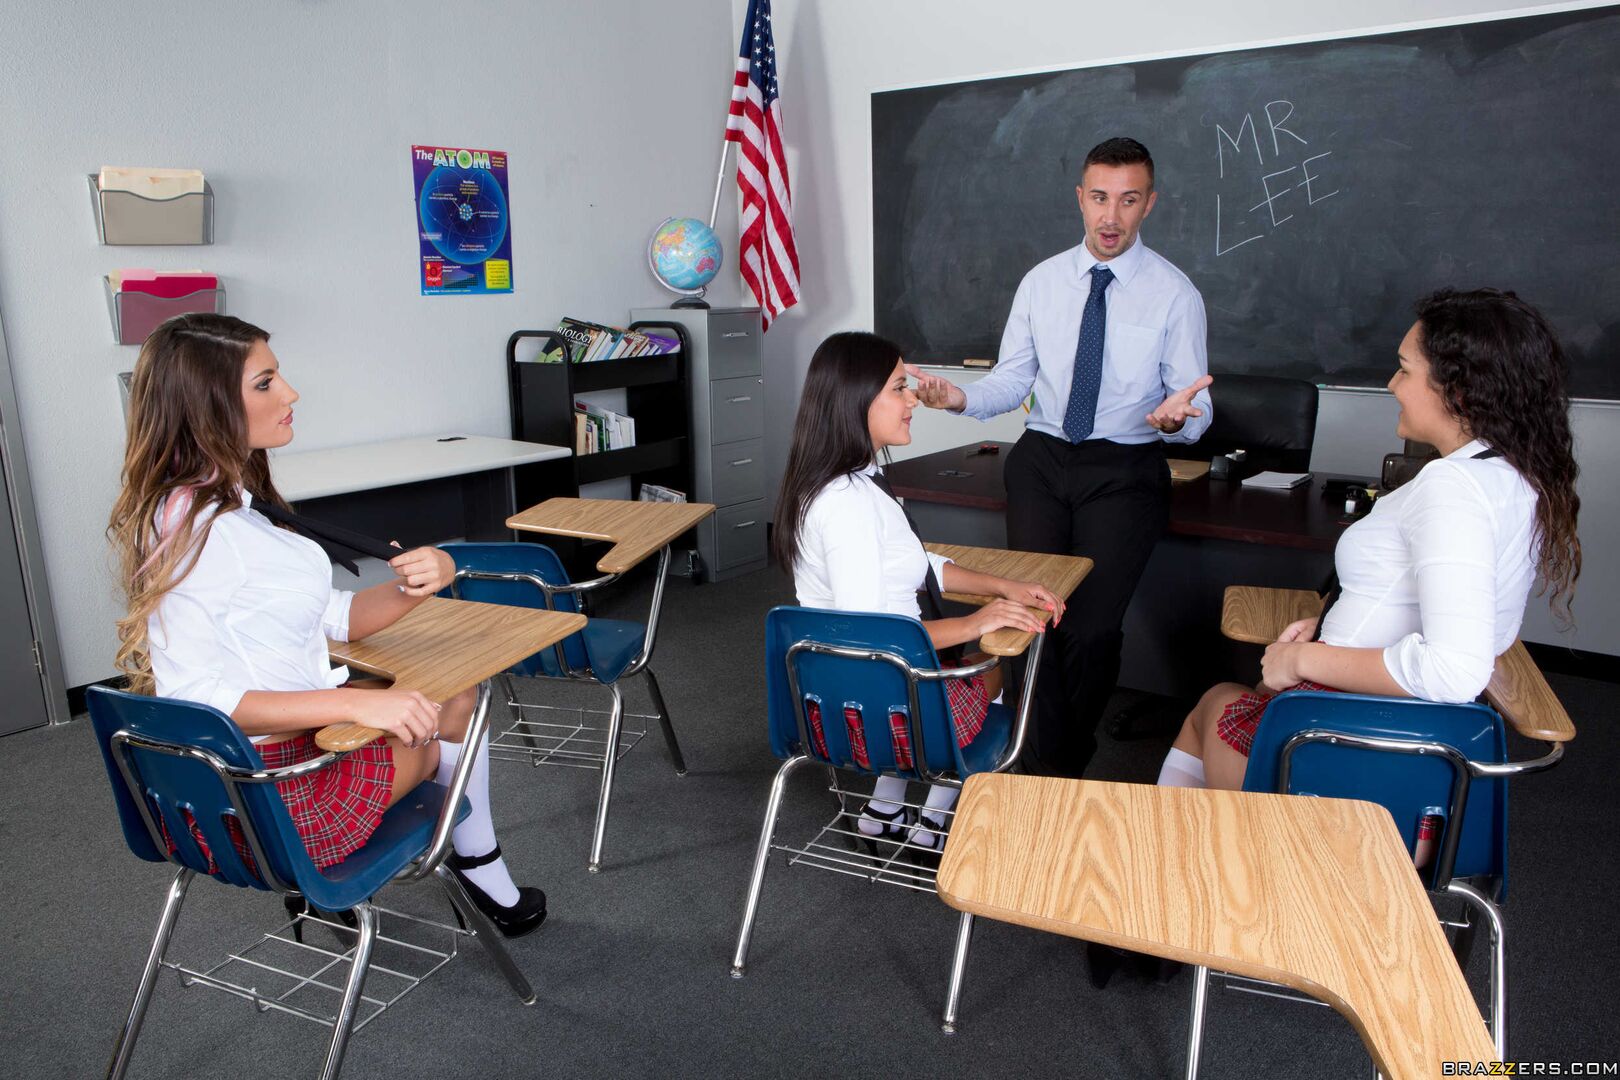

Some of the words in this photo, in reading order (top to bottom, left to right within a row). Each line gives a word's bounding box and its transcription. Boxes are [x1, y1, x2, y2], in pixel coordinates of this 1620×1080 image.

[415, 150, 433, 160] The
[433, 149, 491, 170] ATOM
[1216, 100, 1307, 179] MR
[1216, 151, 1339, 257] LEE
